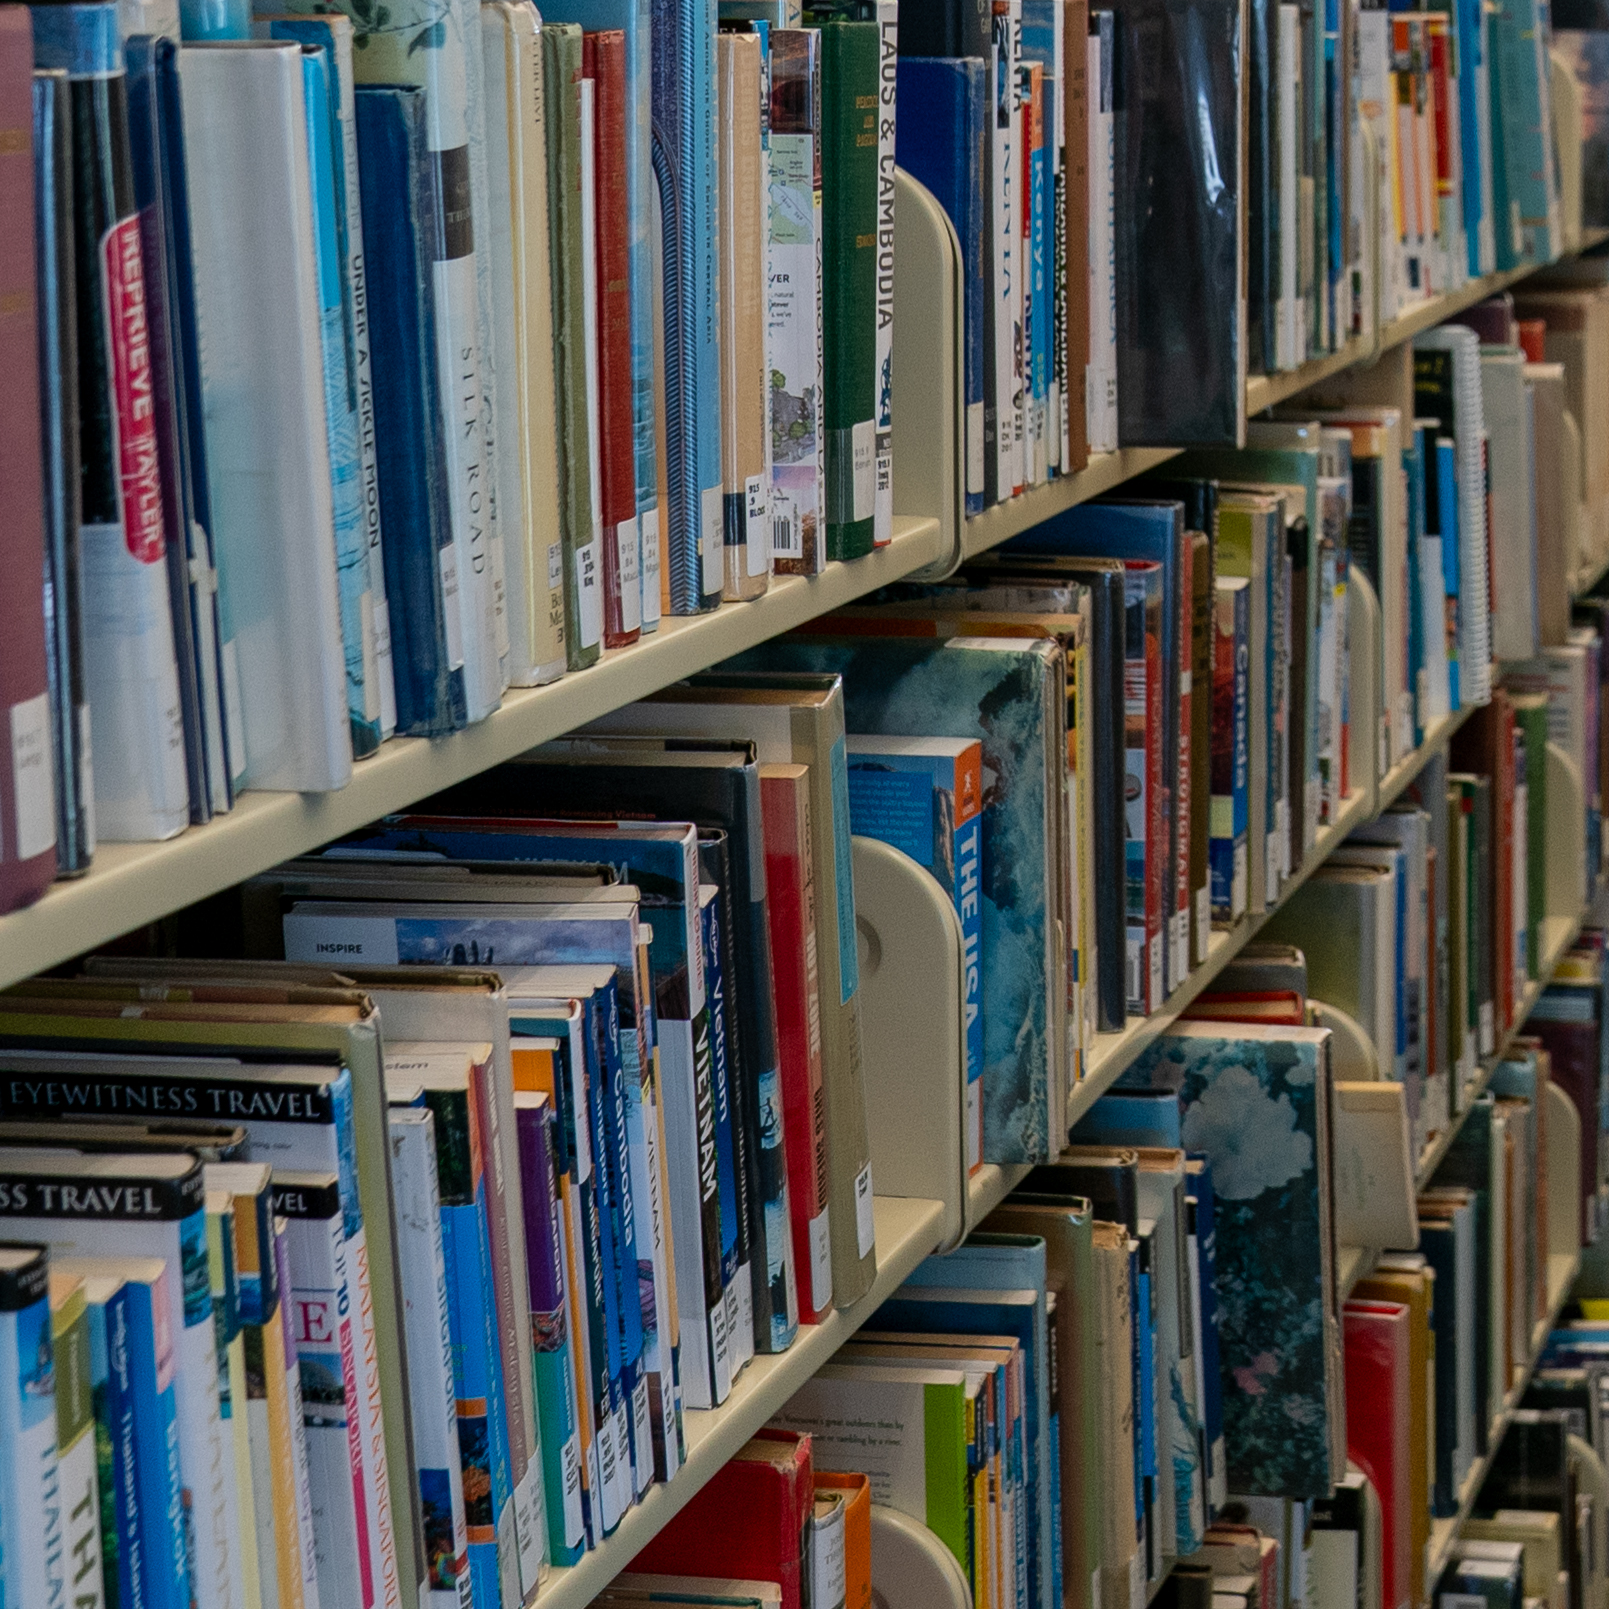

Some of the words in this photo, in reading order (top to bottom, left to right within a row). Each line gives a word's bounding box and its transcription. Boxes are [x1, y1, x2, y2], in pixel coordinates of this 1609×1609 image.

[1033, 160, 1045, 292] Kenya
[121, 228, 156, 422] REPRIEVE
[352, 254, 370, 337] UNDER
[815, 237, 823, 379] CAMBODIA
[357, 346, 369, 366] A
[461, 345, 478, 440] SILK
[358, 375, 376, 456] SICKLE
[816, 390, 824, 440] AND
[135, 441, 163, 549] TAYLER
[363, 463, 381, 549] MOON
[467, 463, 486, 576] ROAD
[1234, 642, 1249, 790] Canada
[959, 826, 979, 921] THE
[315, 942, 364, 956] INSPIRE
[9, 1080, 198, 1114] EYEWITNESS
[205, 1087, 321, 1120] TRAVEL
[711, 974, 730, 1123] Vietnam
[613, 1067, 635, 1249] Cambodia
[693, 1024, 717, 1203] VIETNAM
[647, 1124, 662, 1251] VIETNAM
[331, 1224, 347, 1277] TOP
[335, 1278, 351, 1318] 10
[340, 1327, 363, 1472] SINGAPORE
[165, 1419, 188, 1584] Bangkok
